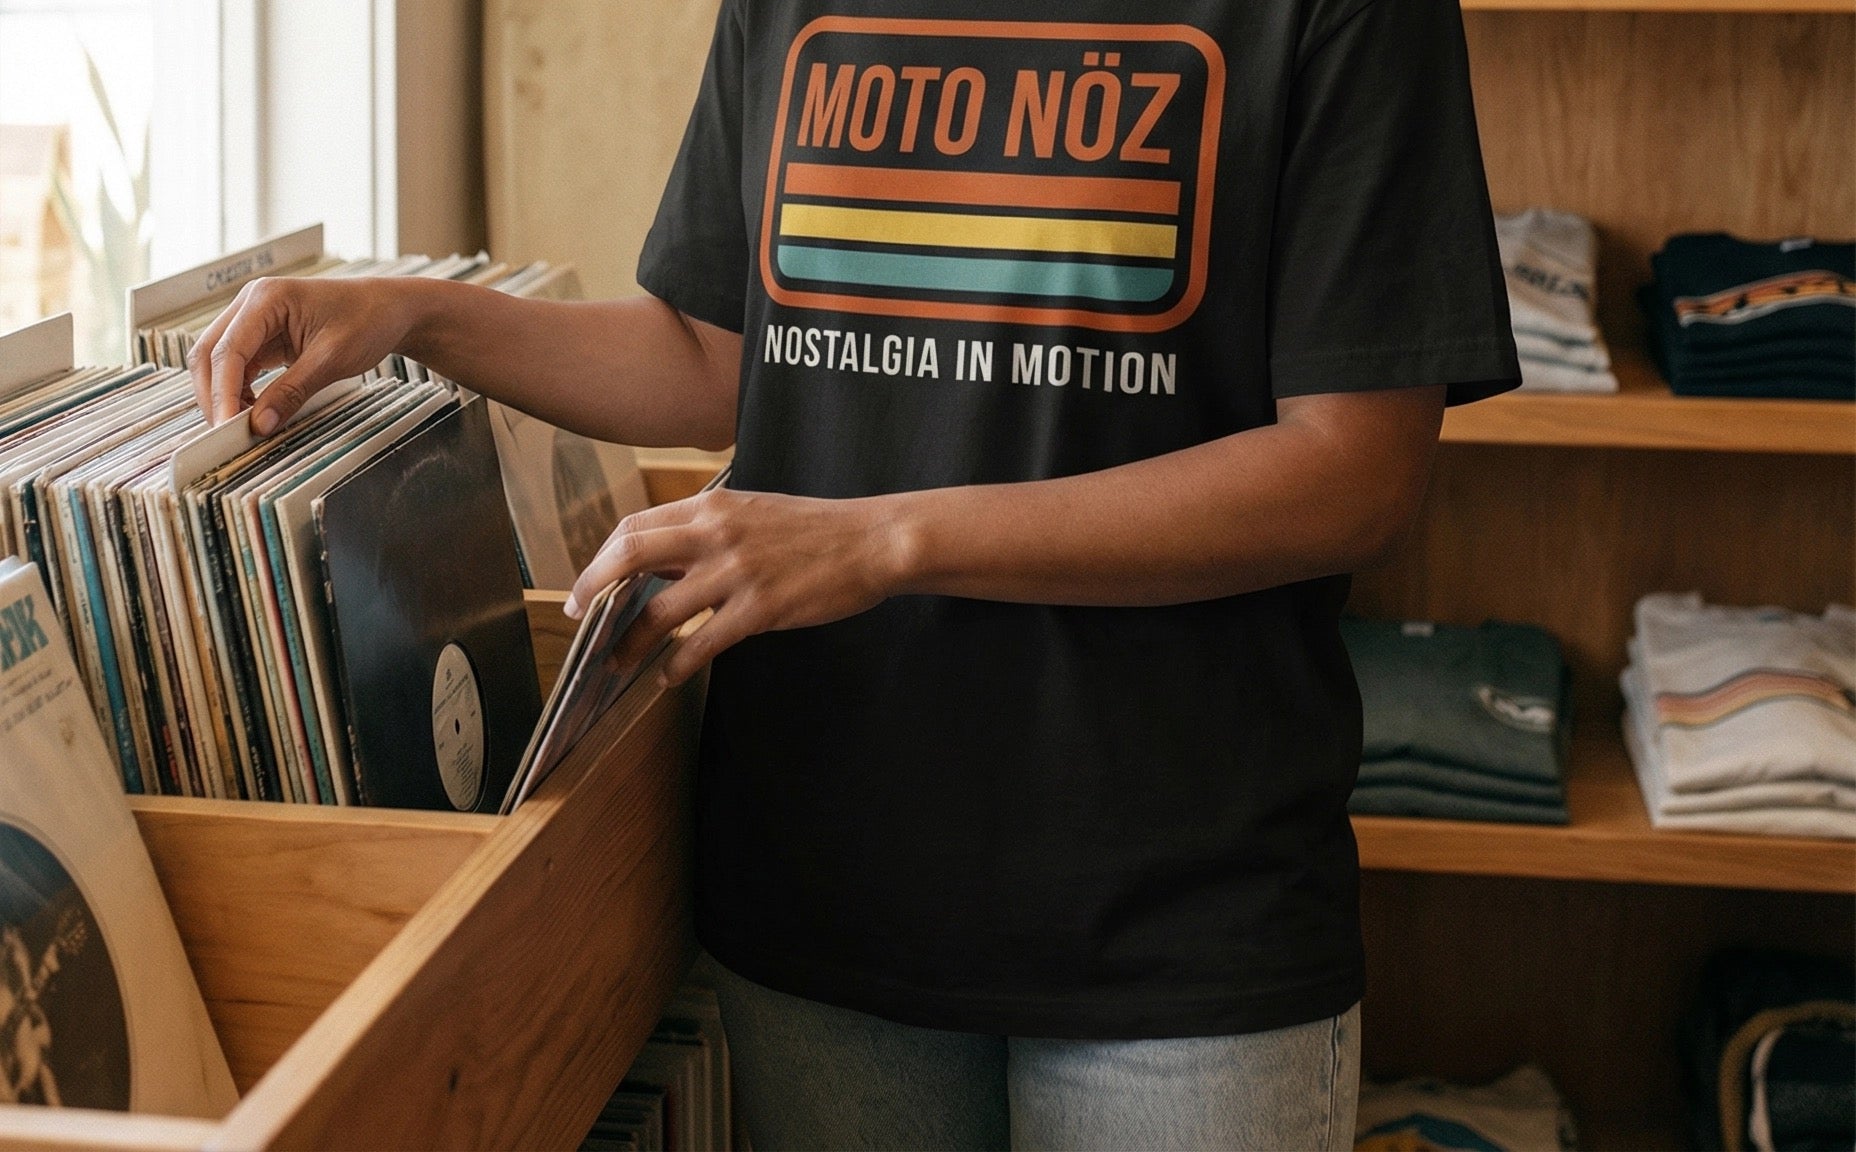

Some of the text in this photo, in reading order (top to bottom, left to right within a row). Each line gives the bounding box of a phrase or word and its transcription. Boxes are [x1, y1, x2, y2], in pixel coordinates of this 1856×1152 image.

[796, 51, 1182, 165] MOTO NÖZ
[764, 324, 1177, 396] NOSTALGIA IN MOTION
